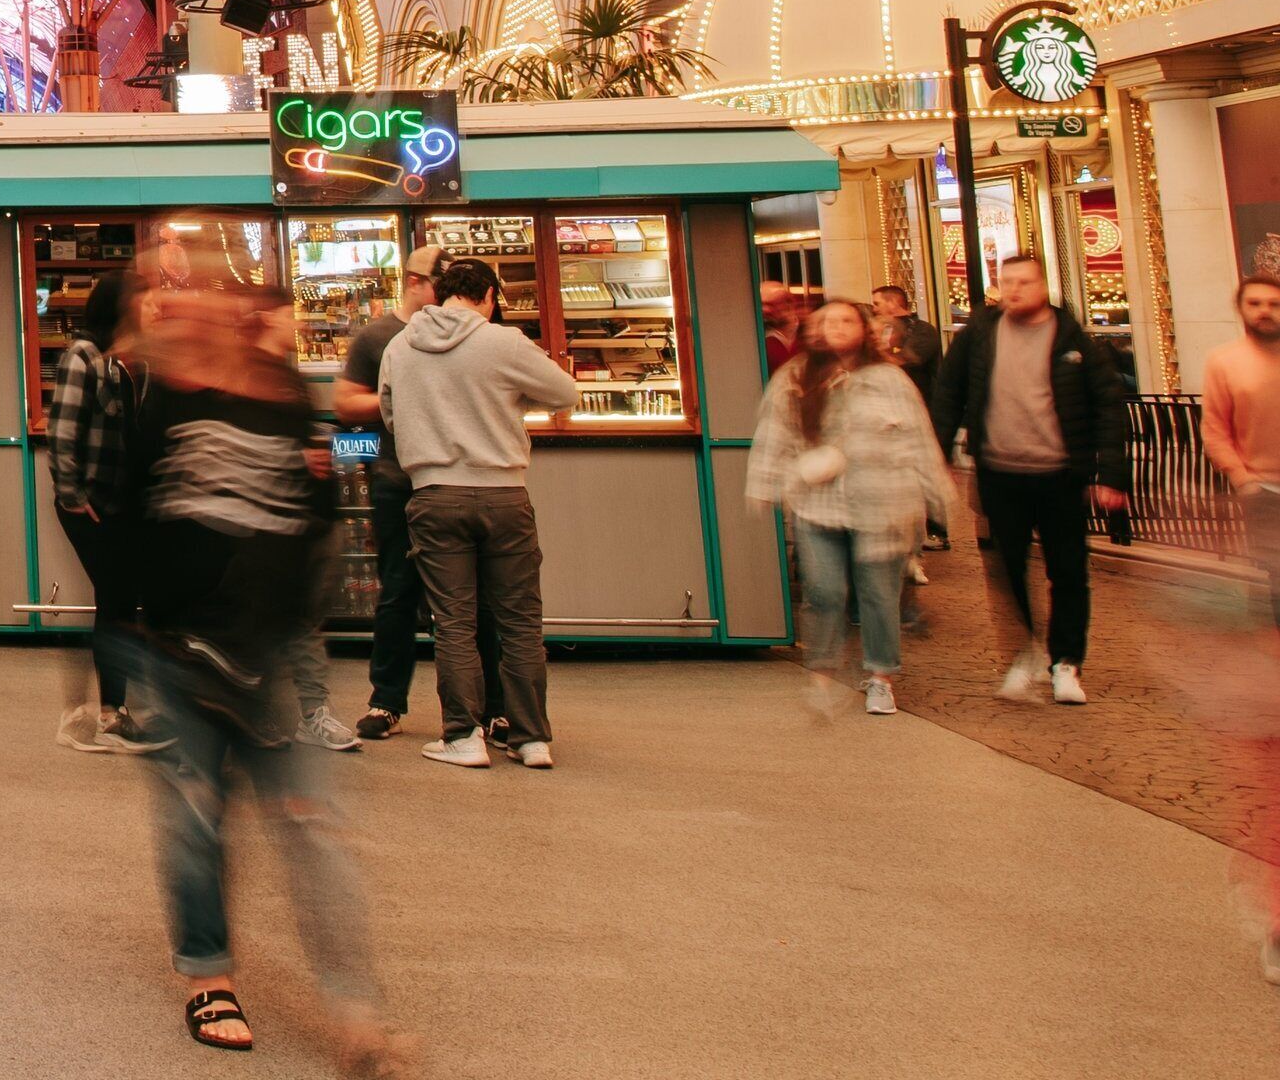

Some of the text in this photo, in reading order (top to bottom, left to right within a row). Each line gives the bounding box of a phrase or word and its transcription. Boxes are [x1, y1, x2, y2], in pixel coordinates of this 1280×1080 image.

[277, 100, 426, 151] Cigars
[343, 486, 350, 495] G
[360, 486, 368, 494] G
